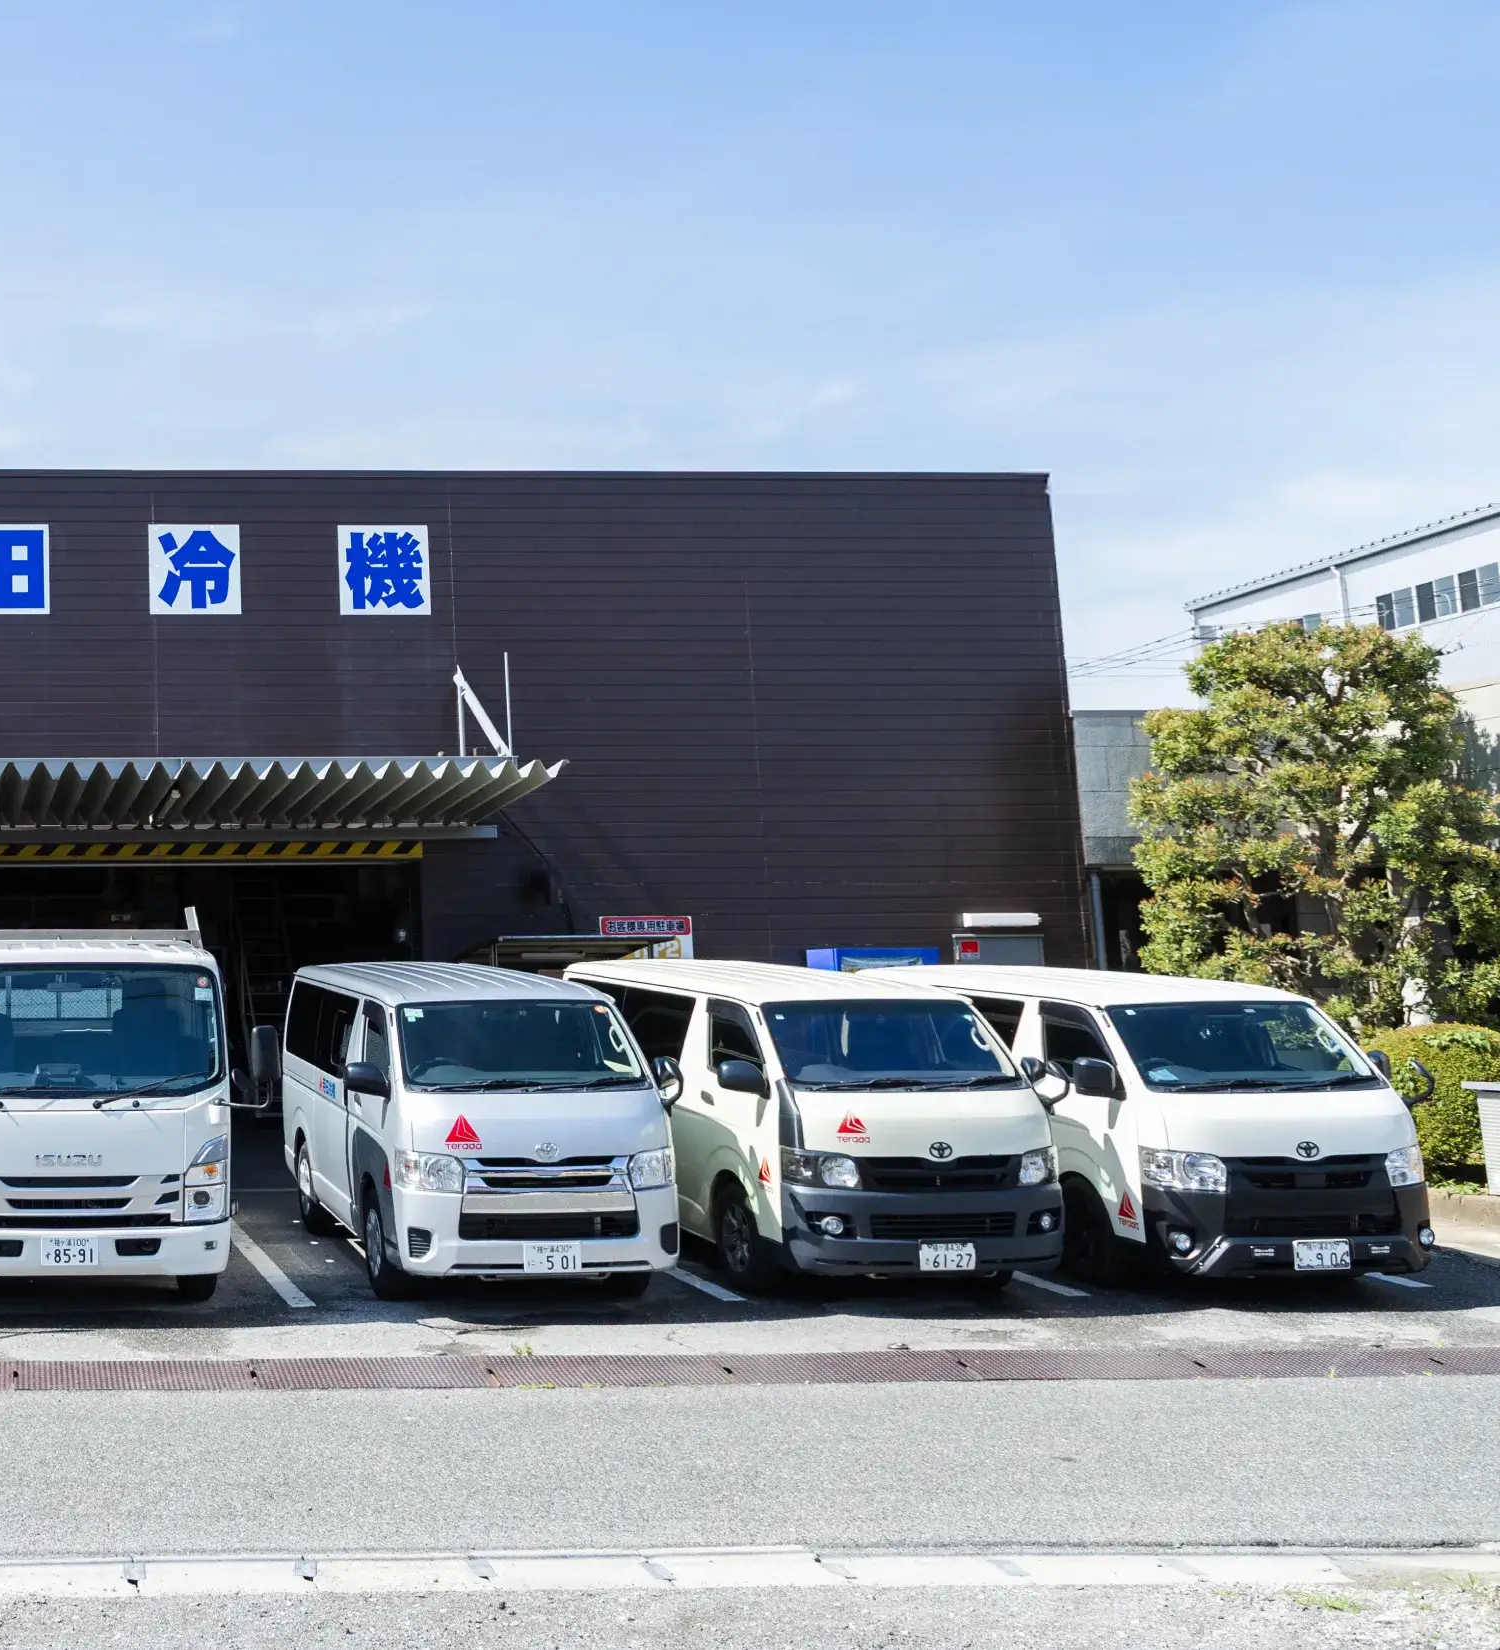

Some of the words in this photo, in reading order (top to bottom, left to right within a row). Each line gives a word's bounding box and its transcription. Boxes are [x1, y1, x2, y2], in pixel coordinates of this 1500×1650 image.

[607, 920, 685, 932] お客様専用駐車場
[836, 1136, 871, 1144] Terada
[35, 1153, 103, 1167] ISUZU
[54, 1248, 93, 1263] 85-91
[932, 1253, 972, 1268] 61-27
